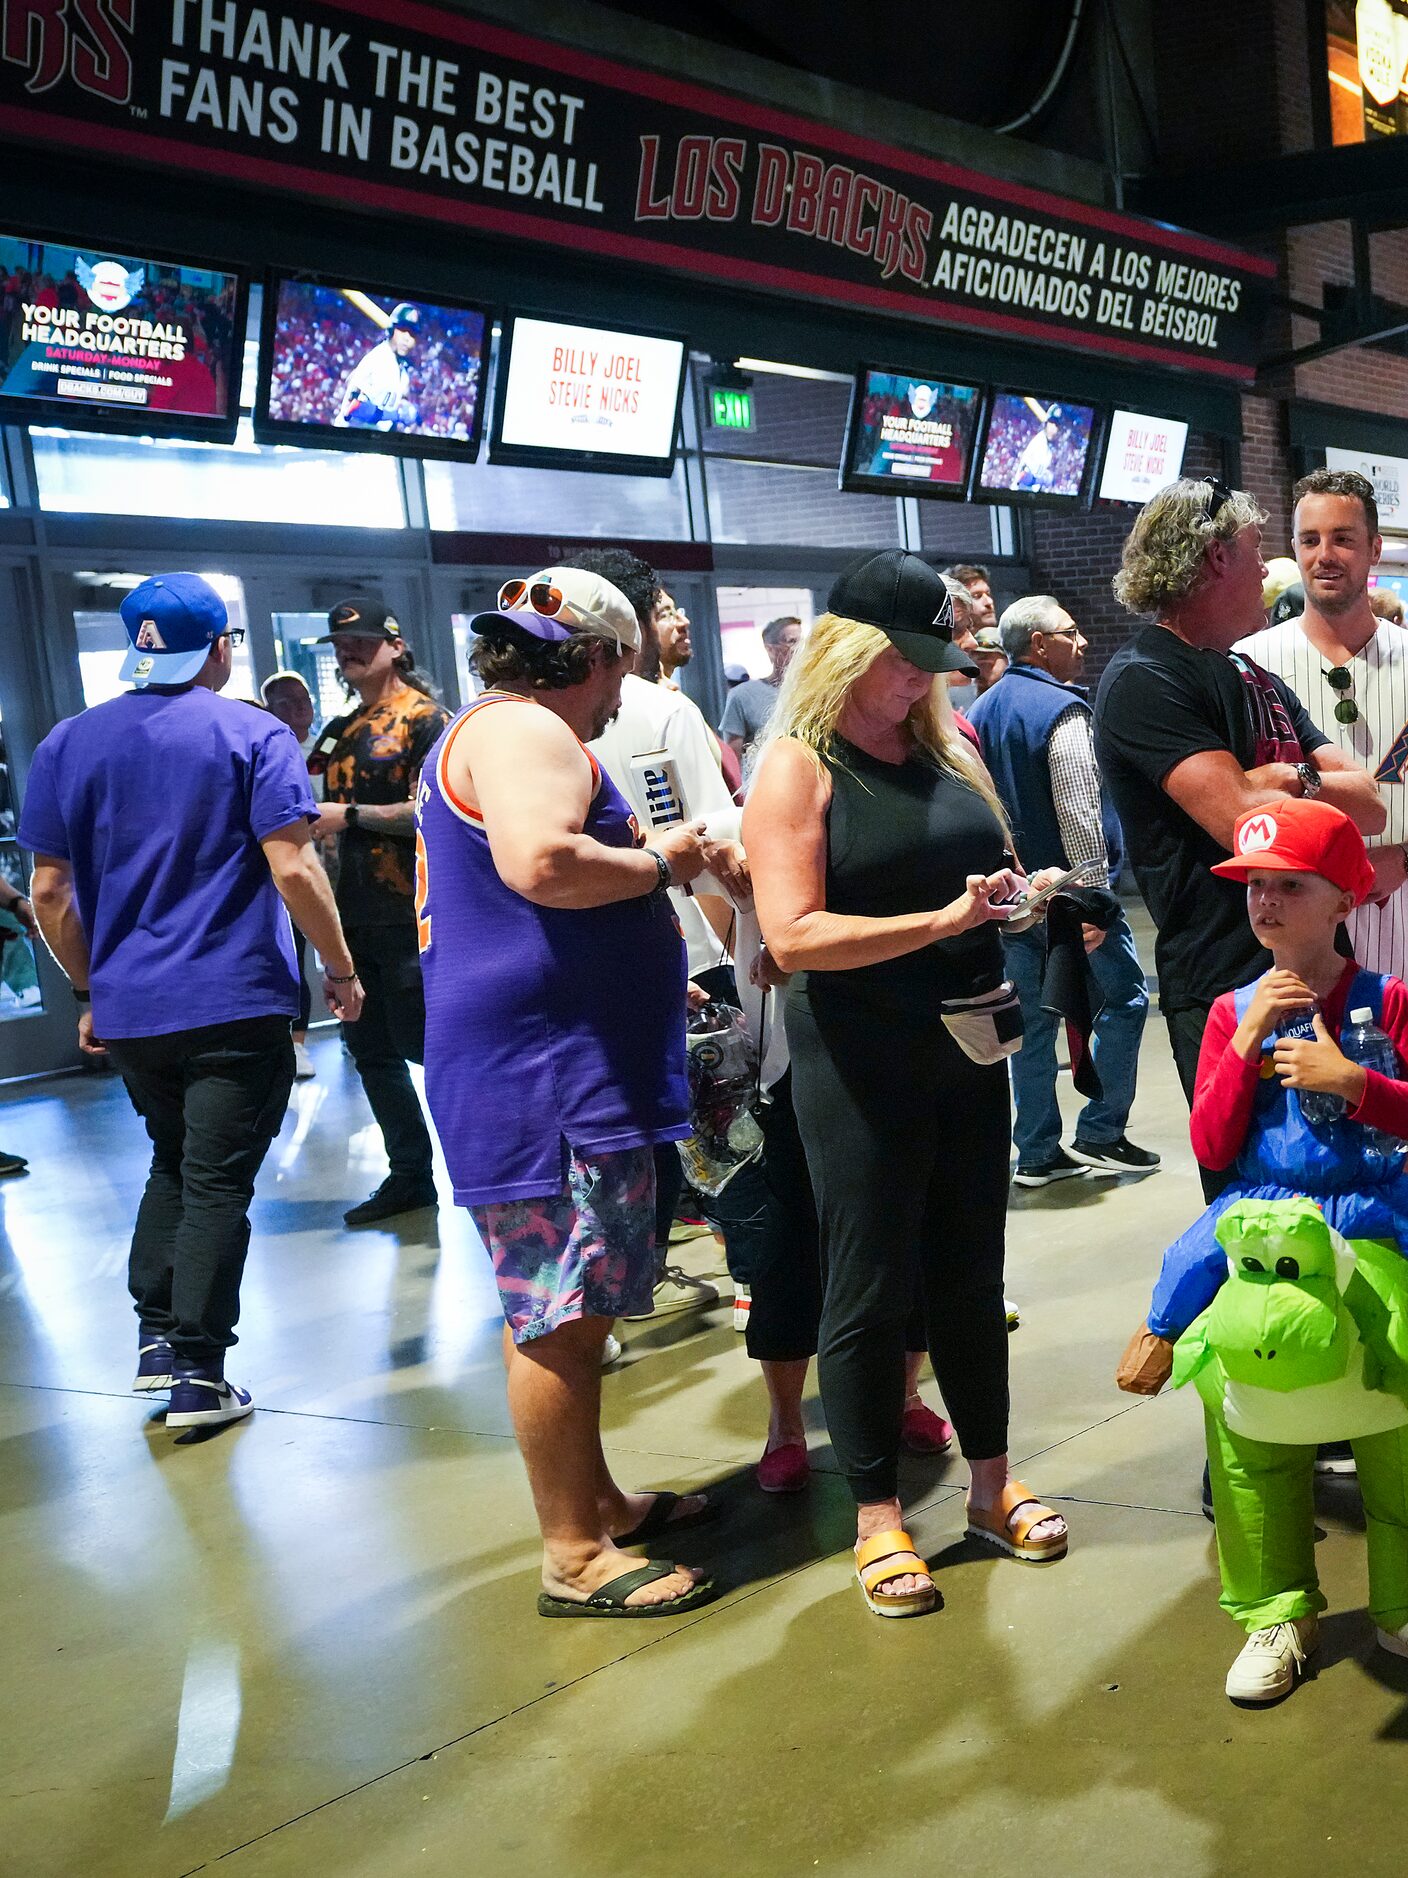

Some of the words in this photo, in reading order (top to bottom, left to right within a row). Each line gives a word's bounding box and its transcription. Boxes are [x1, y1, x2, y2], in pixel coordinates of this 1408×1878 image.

[166, 0, 350, 89] THANK
[369, 41, 459, 116] THE
[475, 71, 585, 145] BEST
[160, 58, 299, 144] FANS
[321, 98, 372, 162] IN
[390, 115, 604, 213] BASEBALL
[635, 135, 746, 221] LOS
[940, 202, 1087, 274] AGRADECEN
[1088, 242, 1105, 279] A
[1110, 248, 1152, 290] LOS
[1155, 260, 1242, 312] MEJORES
[933, 249, 1092, 320] AFICIONADOS
[1096, 288, 1134, 330] DEL
[1140, 296, 1218, 348] BÉISBOL
[21, 302, 81, 329] YOUR
[86, 312, 188, 343] FOOTBALL
[21, 323, 186, 361] HEADQUARTERS
[45, 346, 161, 371] SATURDAY-MONDAY
[31, 361, 59, 373] DRINK
[60, 364, 101, 378] SPECIALS
[108, 370, 134, 383] FOOD
[134, 373, 174, 387] SPECIALS
[553, 347, 598, 376] BILLY
[604, 354, 642, 382] JOEL
[549, 380, 592, 409] STEVIE
[599, 386, 639, 414] NICKS
[882, 415, 908, 430] YOUR
[908, 418, 953, 437] FOOTBALL
[1127, 428, 1148, 450] BILLY
[1149, 431, 1168, 454] JOEL
[1123, 452, 1143, 473] STEVIE
[1146, 455, 1164, 476] NICKS
[1371, 478, 1400, 493] WORLD
[1241, 817, 1271, 846] M
